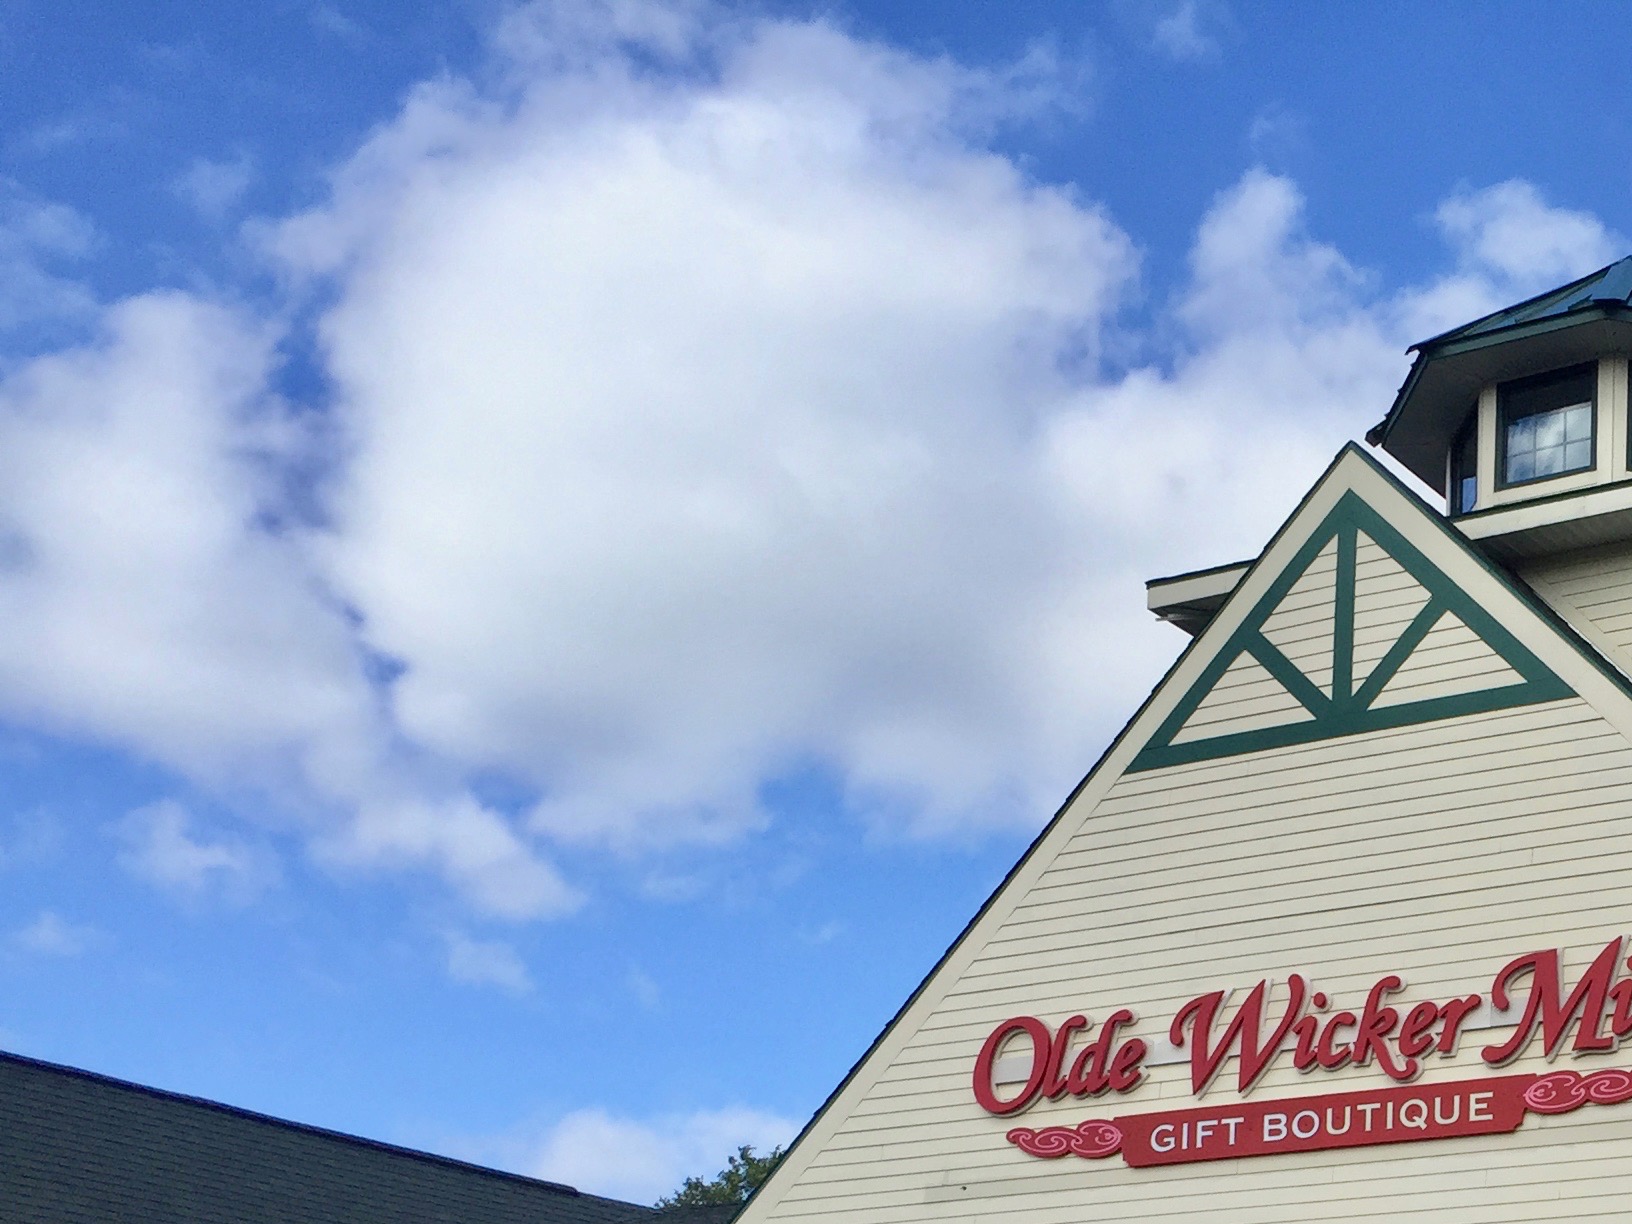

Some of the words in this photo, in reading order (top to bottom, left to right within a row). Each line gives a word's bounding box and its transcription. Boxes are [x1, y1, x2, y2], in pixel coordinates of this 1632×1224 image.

[972, 1008, 1150, 1117] Olde
[1169, 972, 1482, 1083] Wicker
[1149, 1116, 1244, 1153] GIFT
[1261, 1090, 1494, 1143] BOUTIQUE
